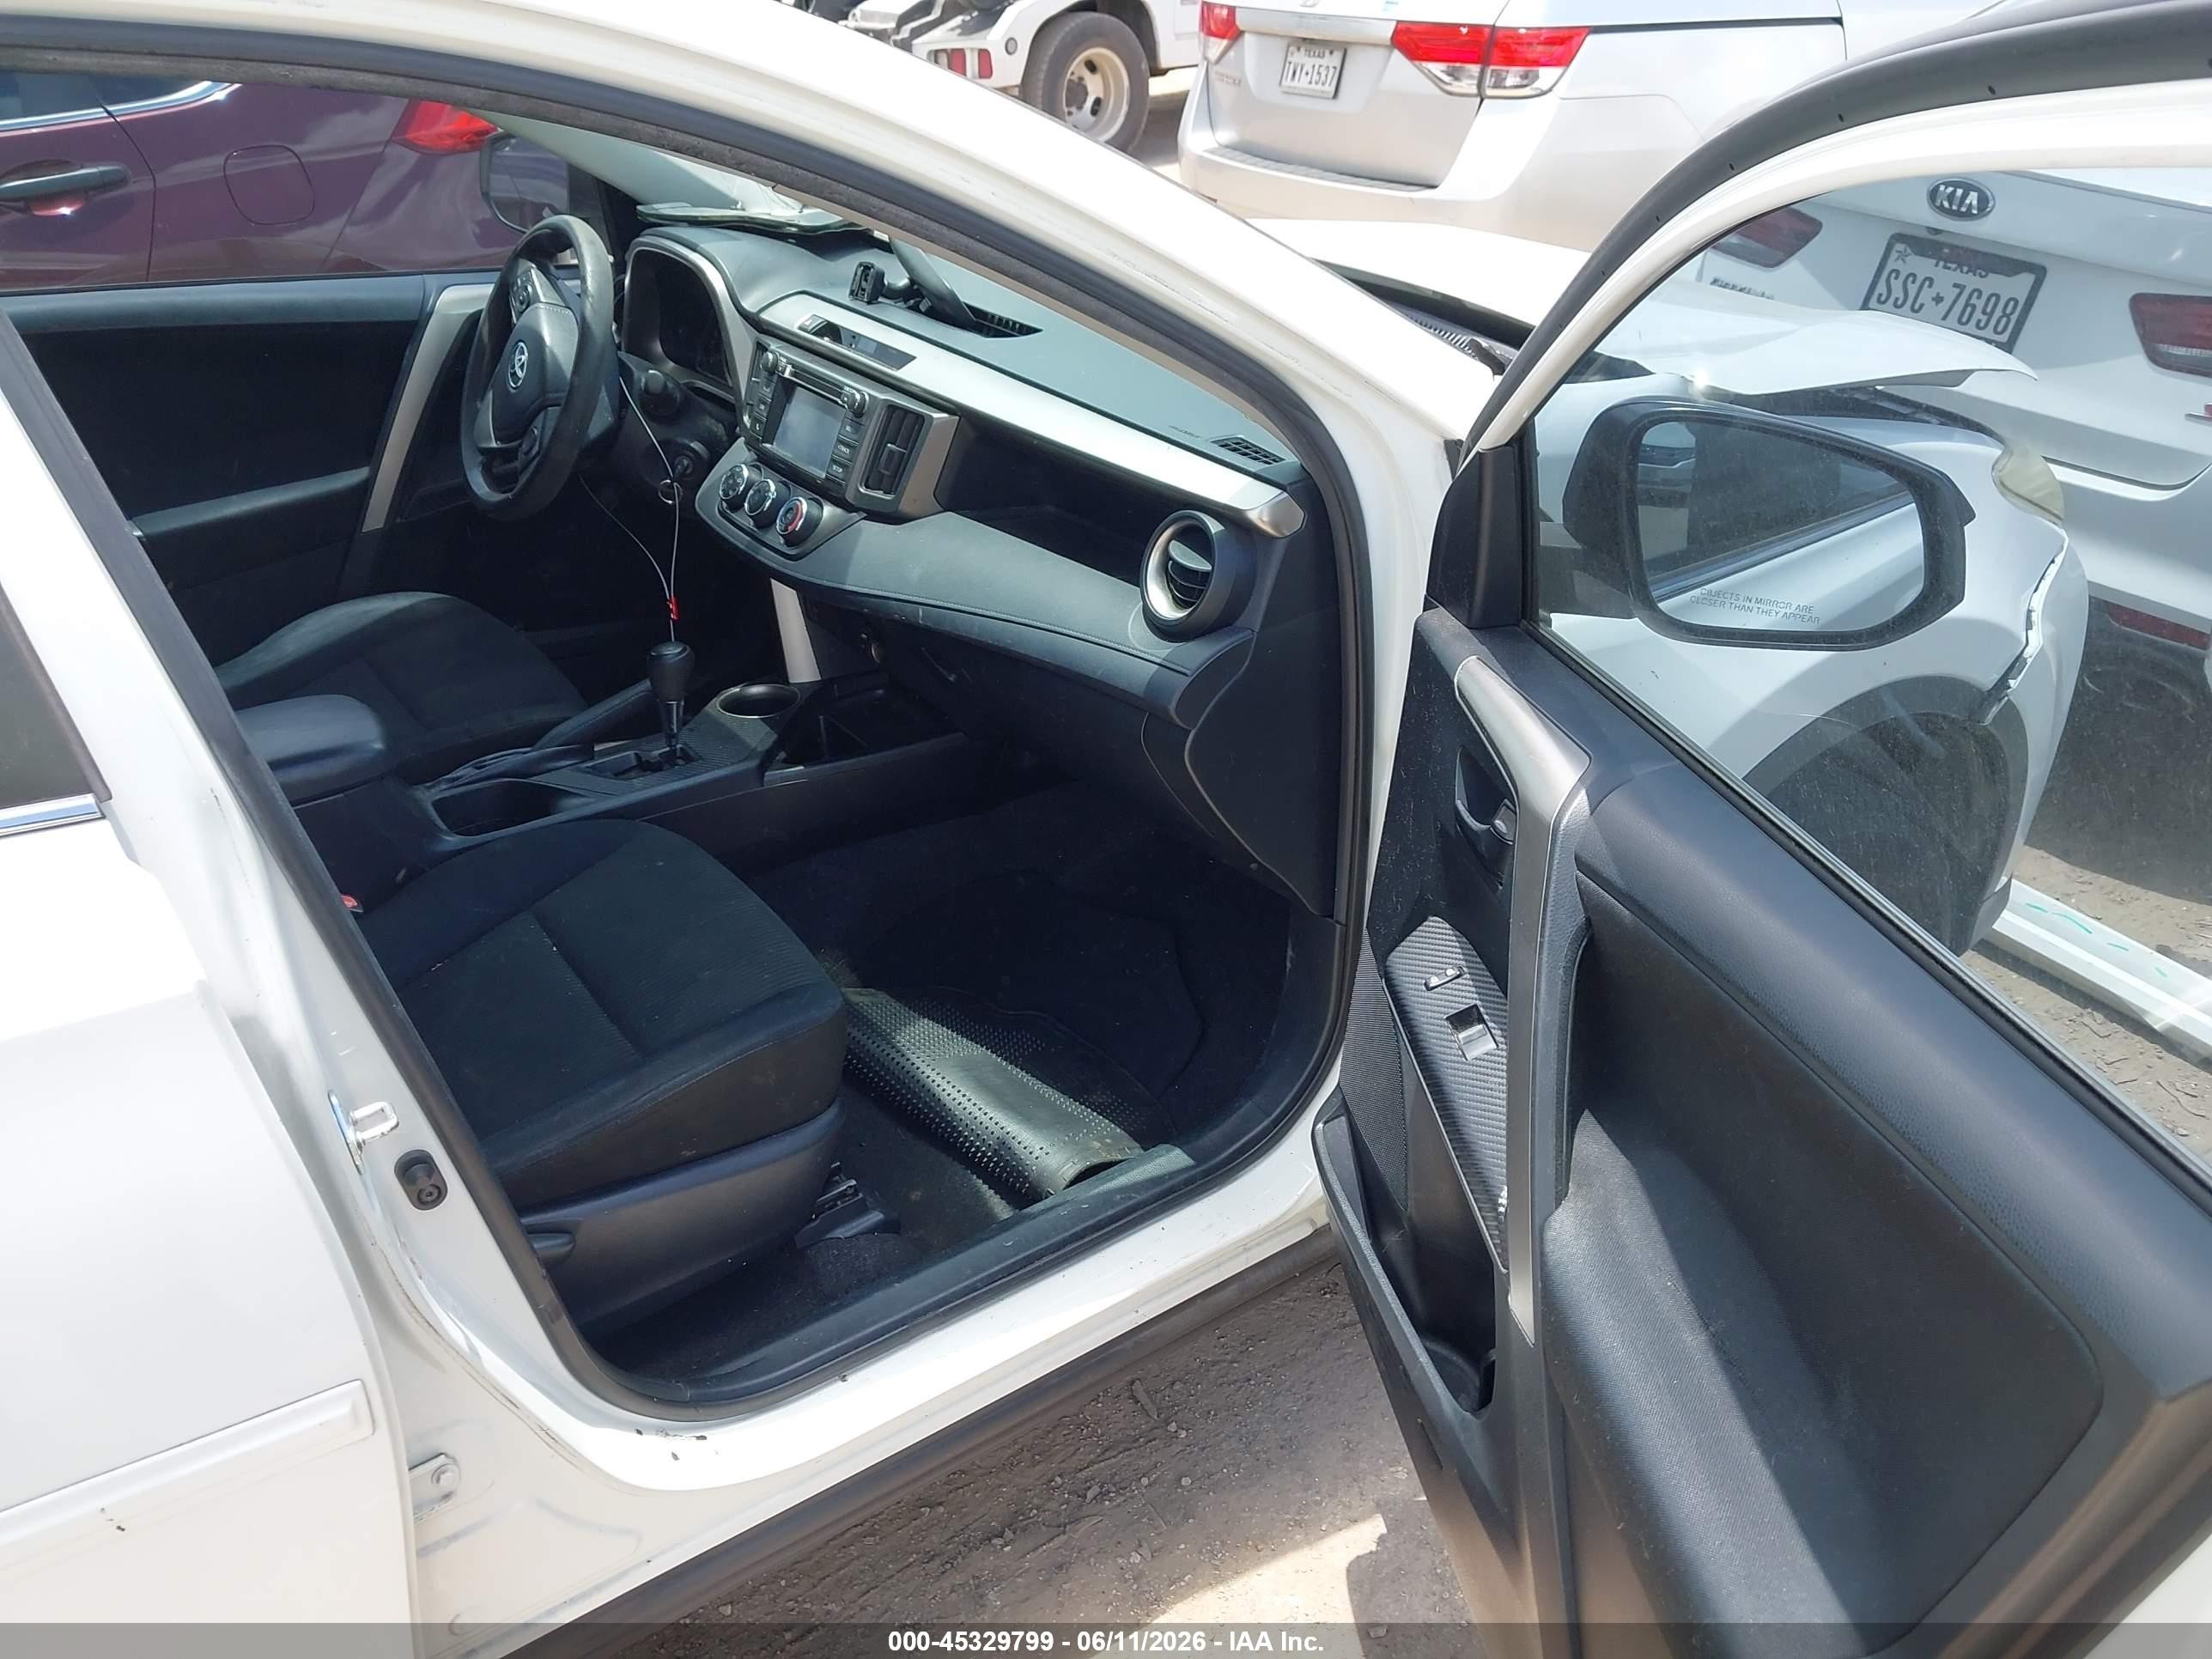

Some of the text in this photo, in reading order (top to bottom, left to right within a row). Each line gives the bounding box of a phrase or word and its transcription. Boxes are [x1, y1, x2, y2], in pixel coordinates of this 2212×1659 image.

[1935, 184, 1979, 214] KIA
[1689, 594, 1821, 625] CLOSER THAN THEY APPEAR
[1742, 594, 1753, 604] IN
[1754, 596, 1794, 611] MIRROR
[1795, 603, 1814, 614] ARE
